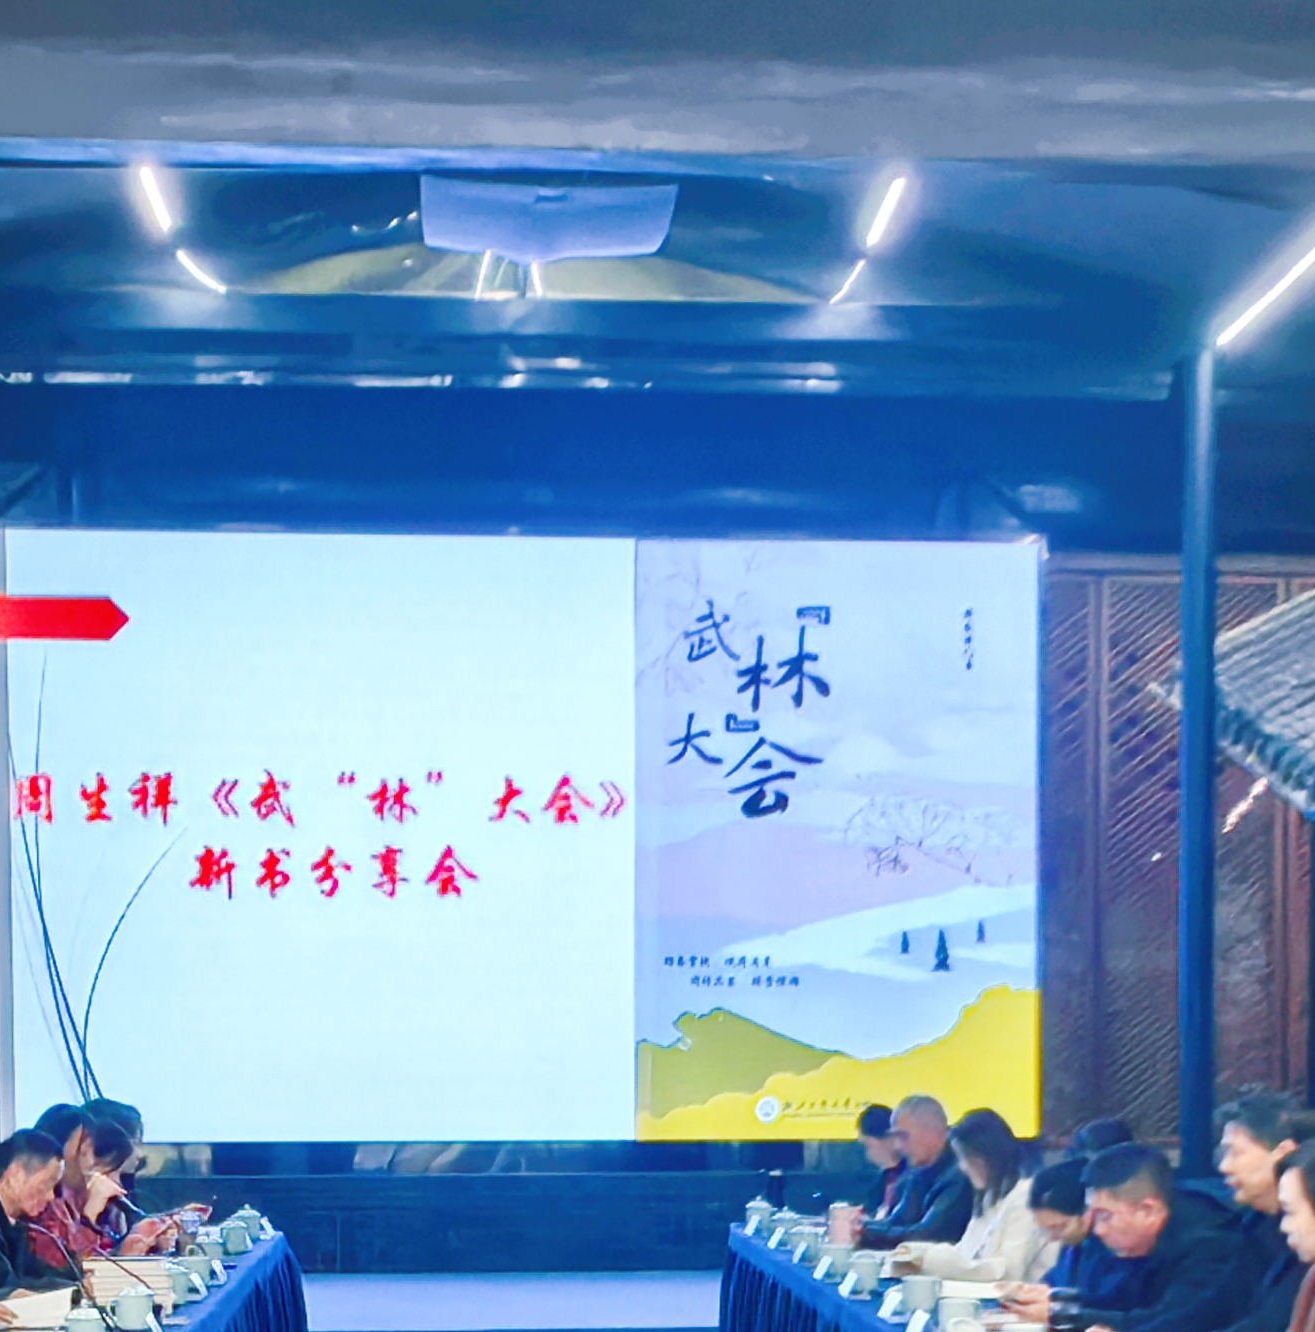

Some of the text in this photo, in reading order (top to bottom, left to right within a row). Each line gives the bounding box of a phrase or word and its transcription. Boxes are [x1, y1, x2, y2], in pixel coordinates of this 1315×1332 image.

[189, 845, 479, 899] 新书分享会
